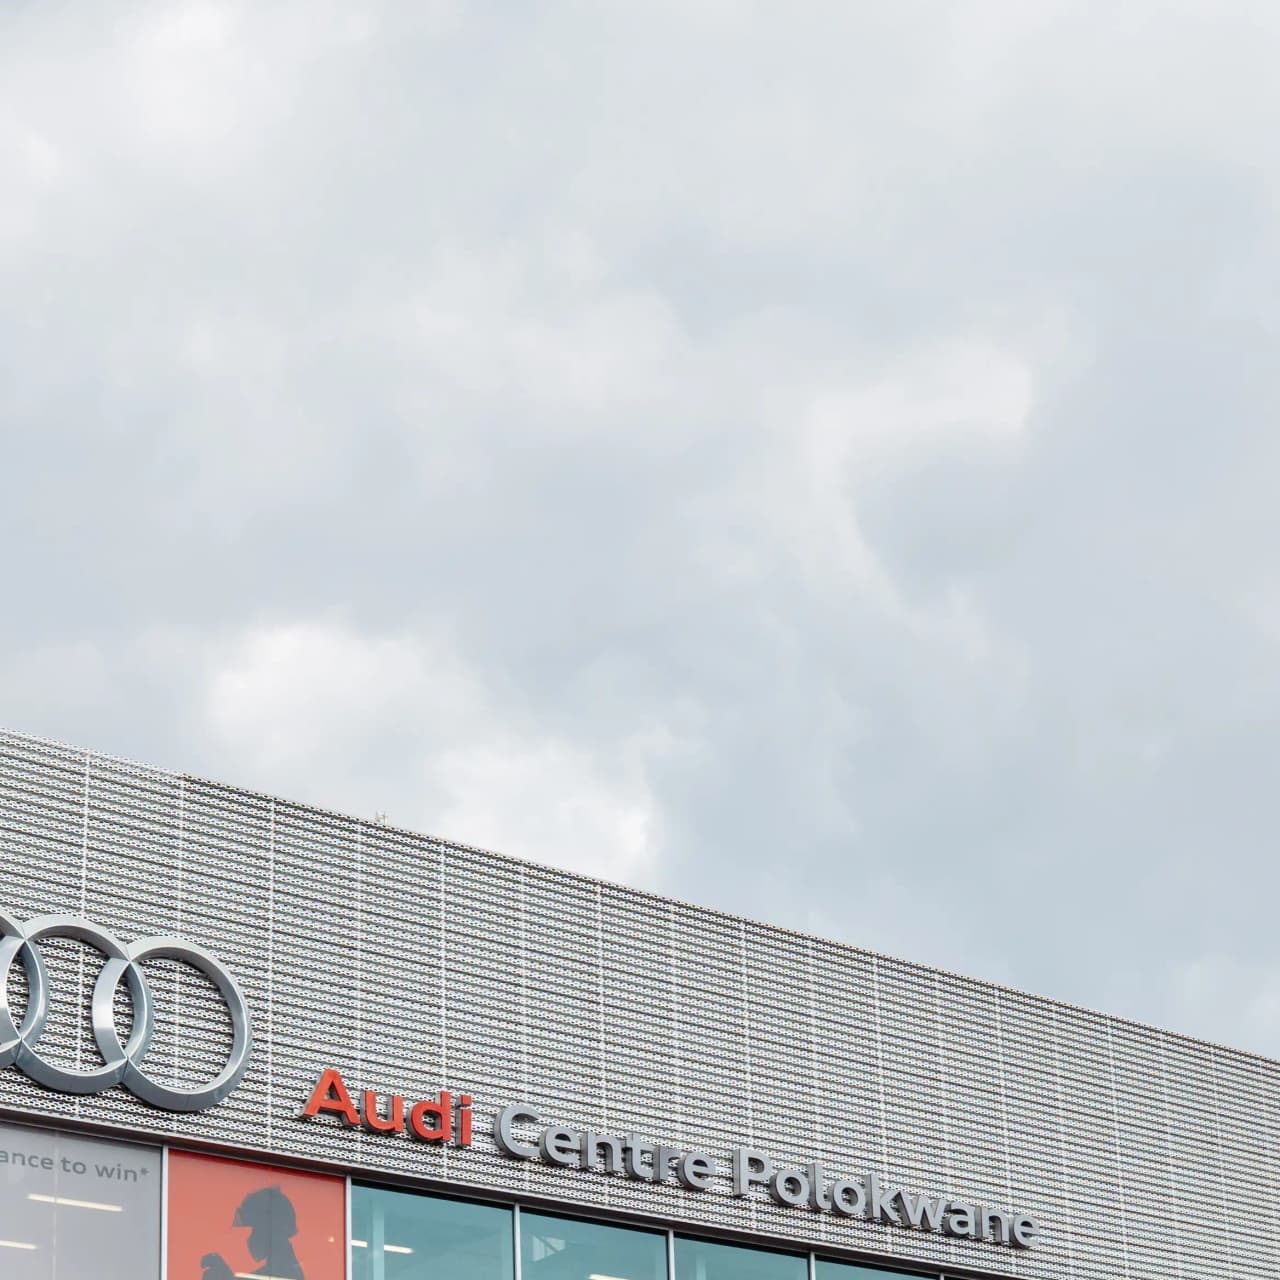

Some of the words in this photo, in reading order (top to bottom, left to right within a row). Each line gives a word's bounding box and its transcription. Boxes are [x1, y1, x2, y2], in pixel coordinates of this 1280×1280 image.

[61, 1156, 87, 1175] to
[301, 1068, 472, 1147] Audi
[494, 1103, 717, 1192] Centre
[733, 1150, 1041, 1249] Polokwane
